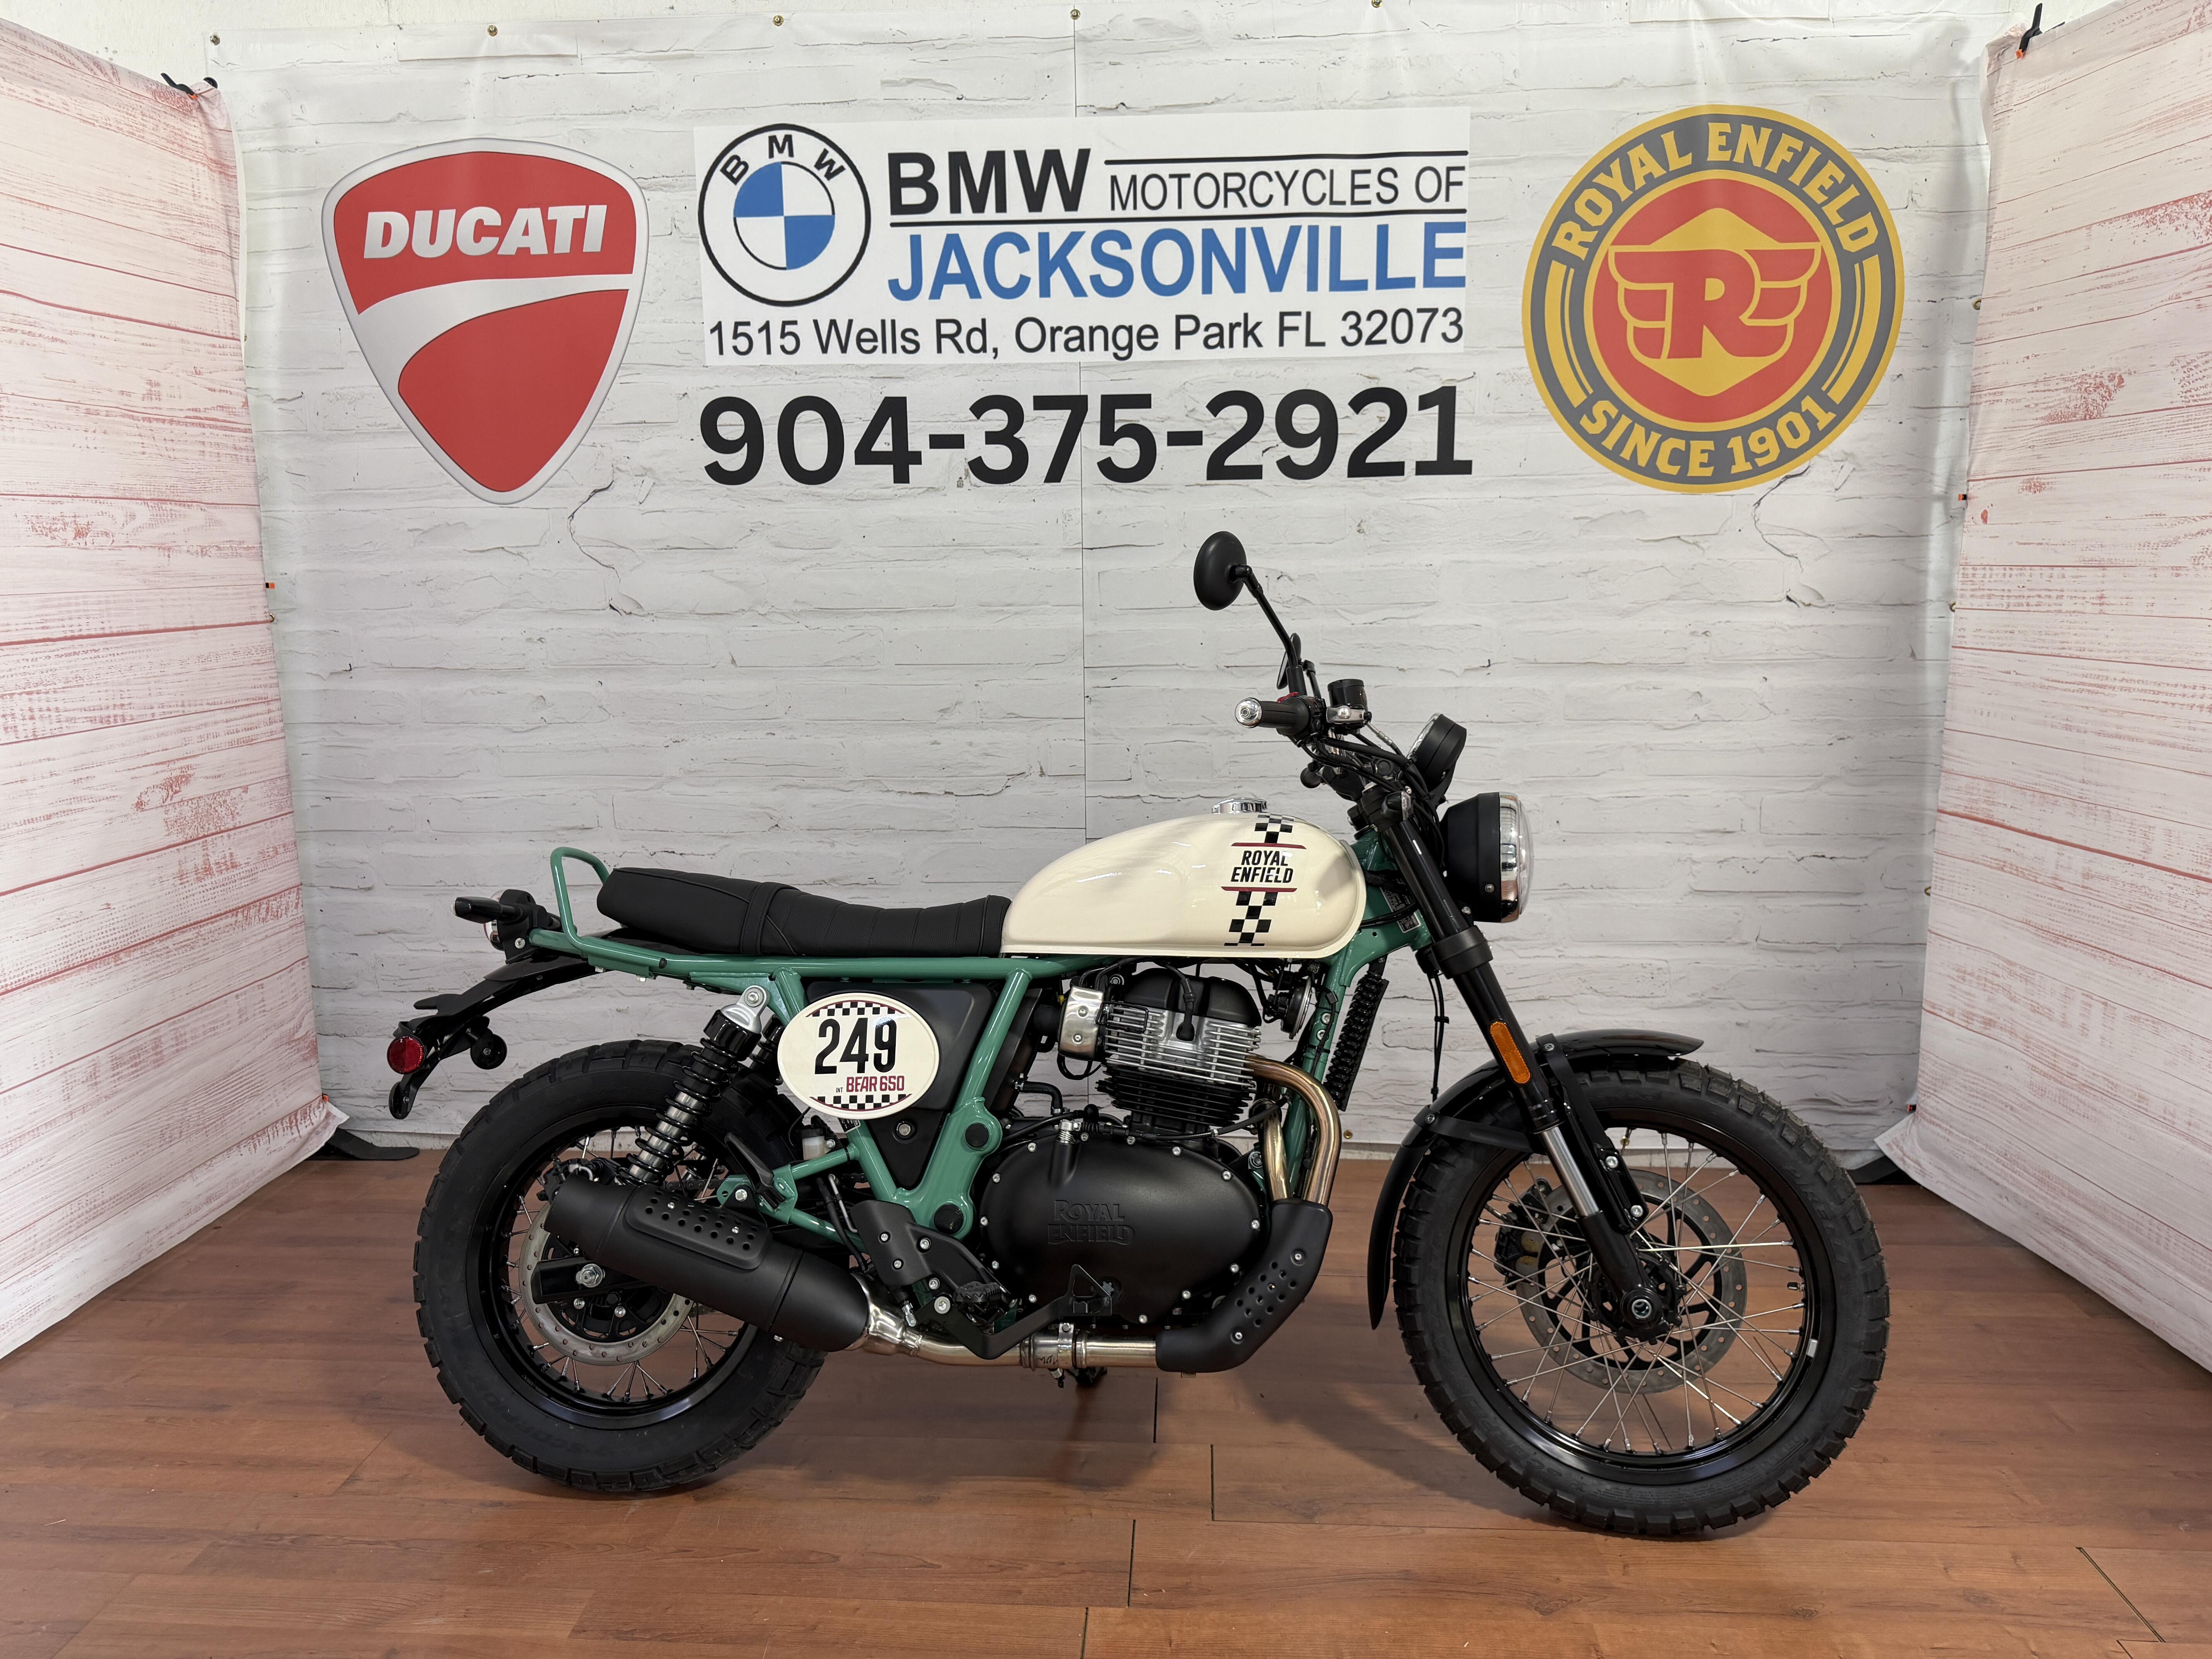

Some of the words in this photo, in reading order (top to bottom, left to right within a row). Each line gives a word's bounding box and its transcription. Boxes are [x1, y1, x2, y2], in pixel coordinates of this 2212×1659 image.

[720, 134, 846, 185] BMW
[888, 148, 1091, 215] BMW
[1110, 167, 1399, 211] MOTORCYCLES
[1415, 165, 1465, 203] OF
[1551, 130, 1692, 261] ROYAL
[1706, 122, 1879, 253] ENFIELD
[364, 204, 607, 259] DUCATI
[888, 222, 1466, 301] JACKSONVILLE
[710, 320, 800, 356] 1515
[812, 319, 921, 354] Wells
[935, 318, 998, 360] Rd,
[1015, 316, 1159, 361] Orange
[1175, 313, 1263, 350] Park
[1278, 311, 1326, 347] FL
[1341, 307, 1463, 347] 32073
[700, 386, 1473, 486] 904-375-2921
[1579, 399, 1715, 477] SINCE
[1727, 395, 1836, 474] 1901
[1230, 867, 1294, 883] ENFIELD
[1241, 850, 1288, 866] ROYAL
[814, 1017, 897, 1074] 249
[846, 1076, 878, 1092] BEAR
[879, 1075, 905, 1091] 650
[1047, 1224, 1135, 1246] ENFIELD
[1054, 1199, 1125, 1223] ROYAL
[1781, 1160, 1849, 1265] PIRELLI
